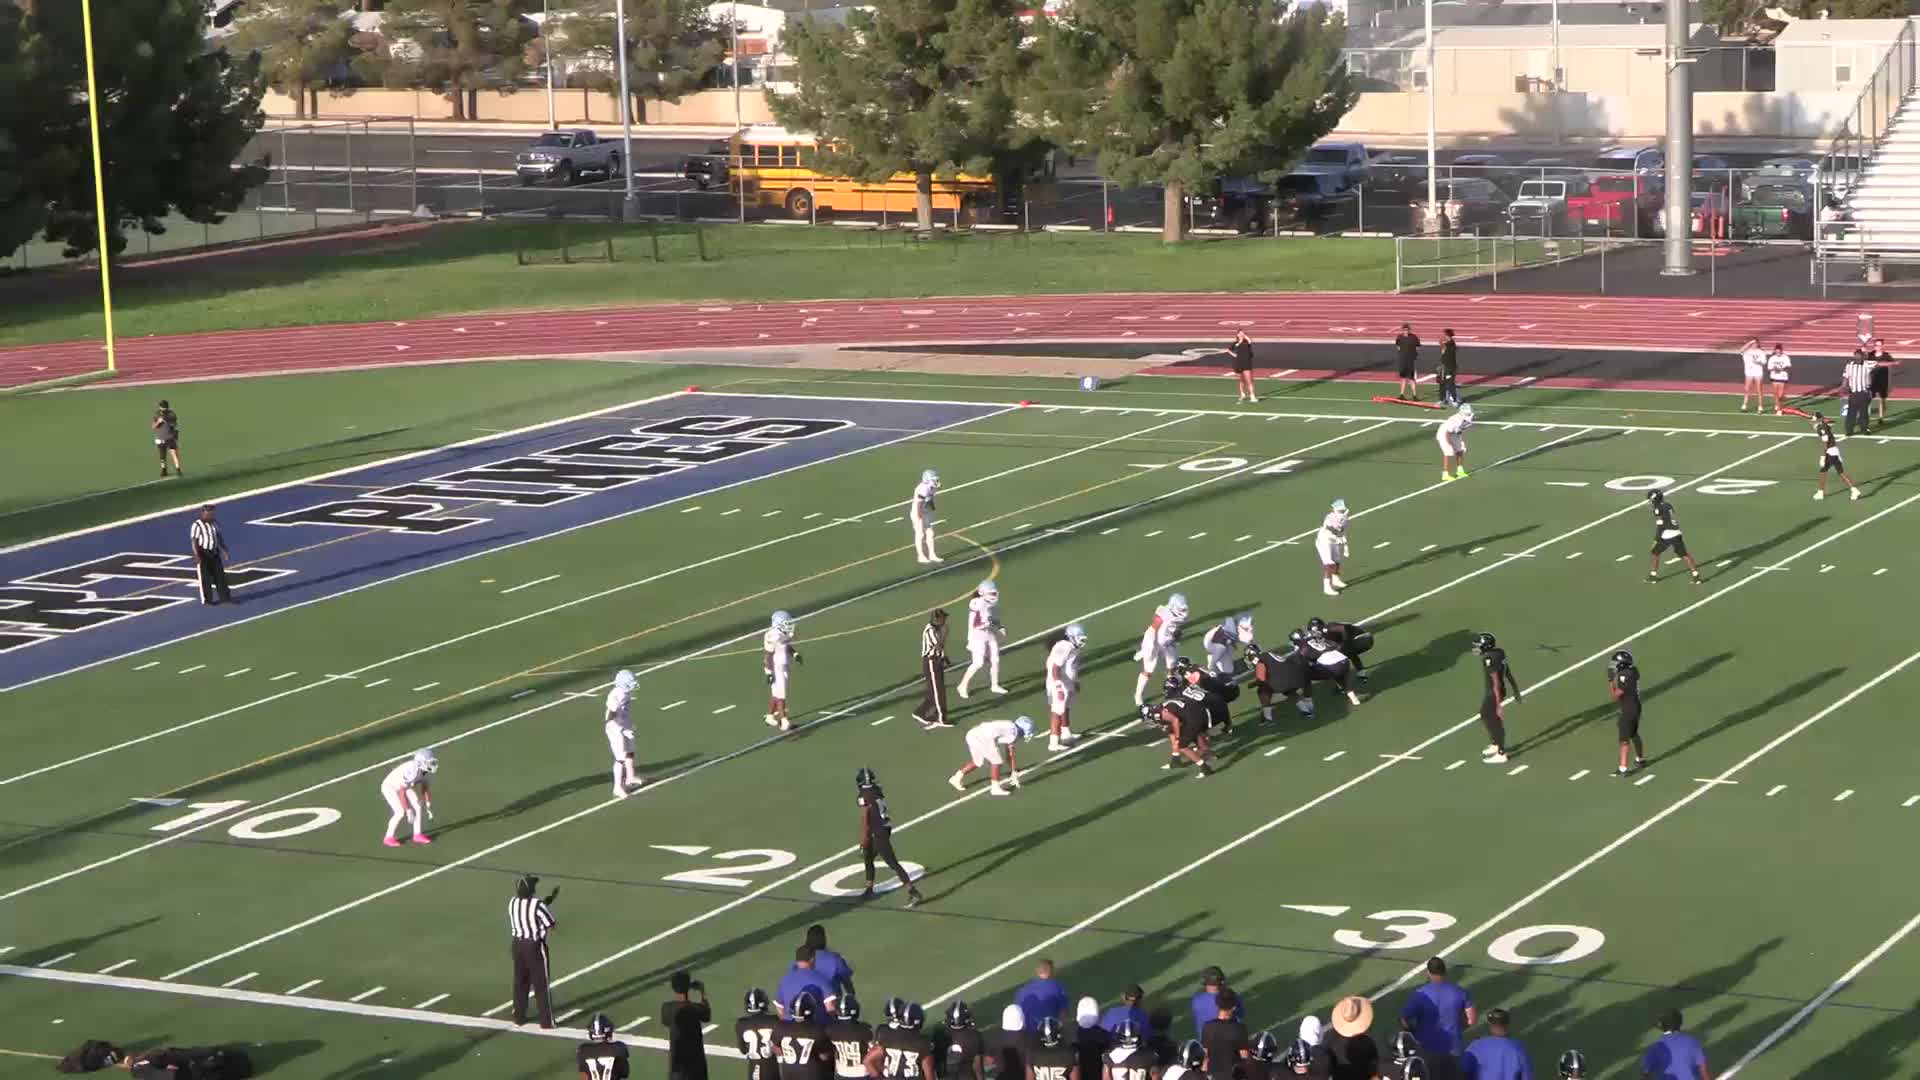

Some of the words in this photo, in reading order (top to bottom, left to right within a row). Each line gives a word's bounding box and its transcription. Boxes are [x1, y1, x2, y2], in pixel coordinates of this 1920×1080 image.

[247, 415, 855, 534] PINES
[1178, 457, 1305, 474] 10
[1604, 475, 1780, 495] 20
[148, 799, 342, 840] 10
[661, 849, 925, 897] 20
[1334, 909, 1606, 965] 30
[585, 1057, 616, 1080] 17
